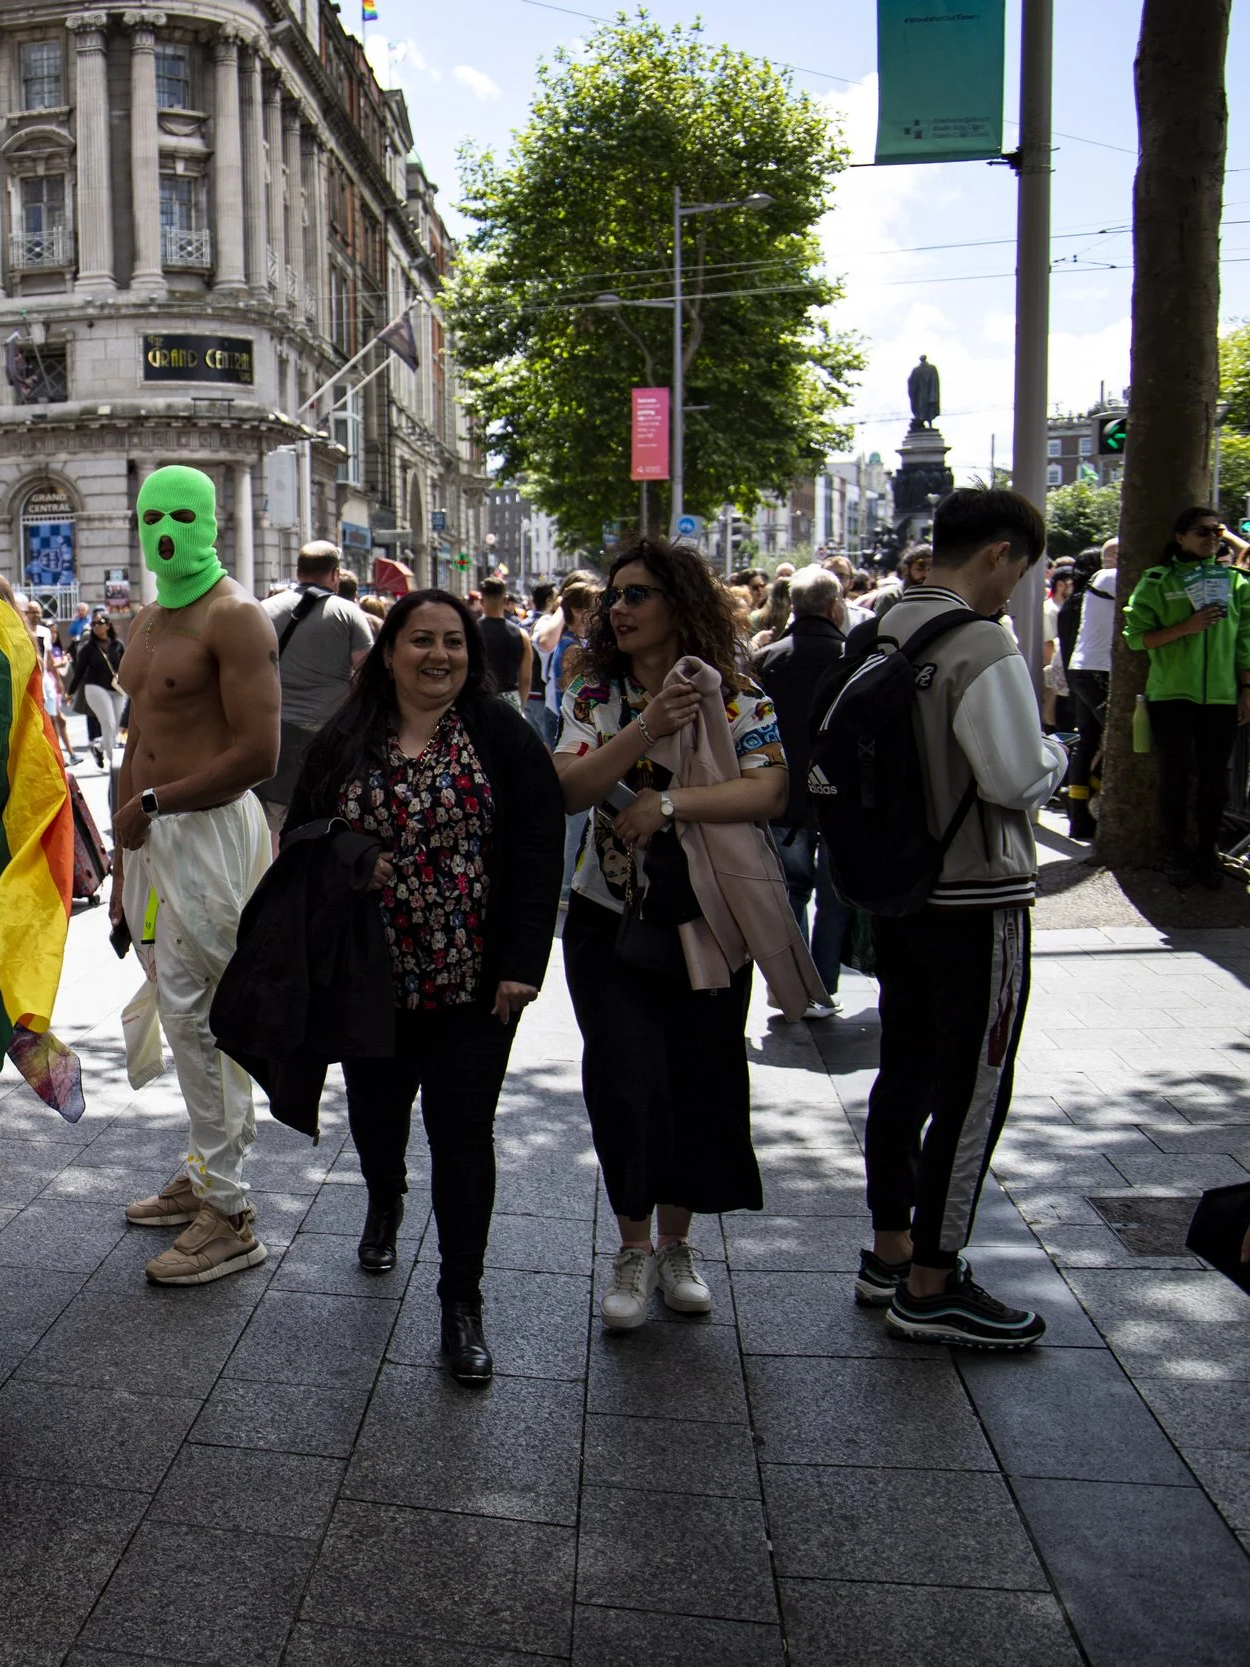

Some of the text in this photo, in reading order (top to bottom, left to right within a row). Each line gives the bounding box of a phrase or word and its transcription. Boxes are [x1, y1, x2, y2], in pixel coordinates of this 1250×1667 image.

[148, 347, 199, 369] GRAND
[31, 493, 67, 502] GRAND
[28, 503, 72, 513] CENTRAL
[807, 784, 838, 795] didas
